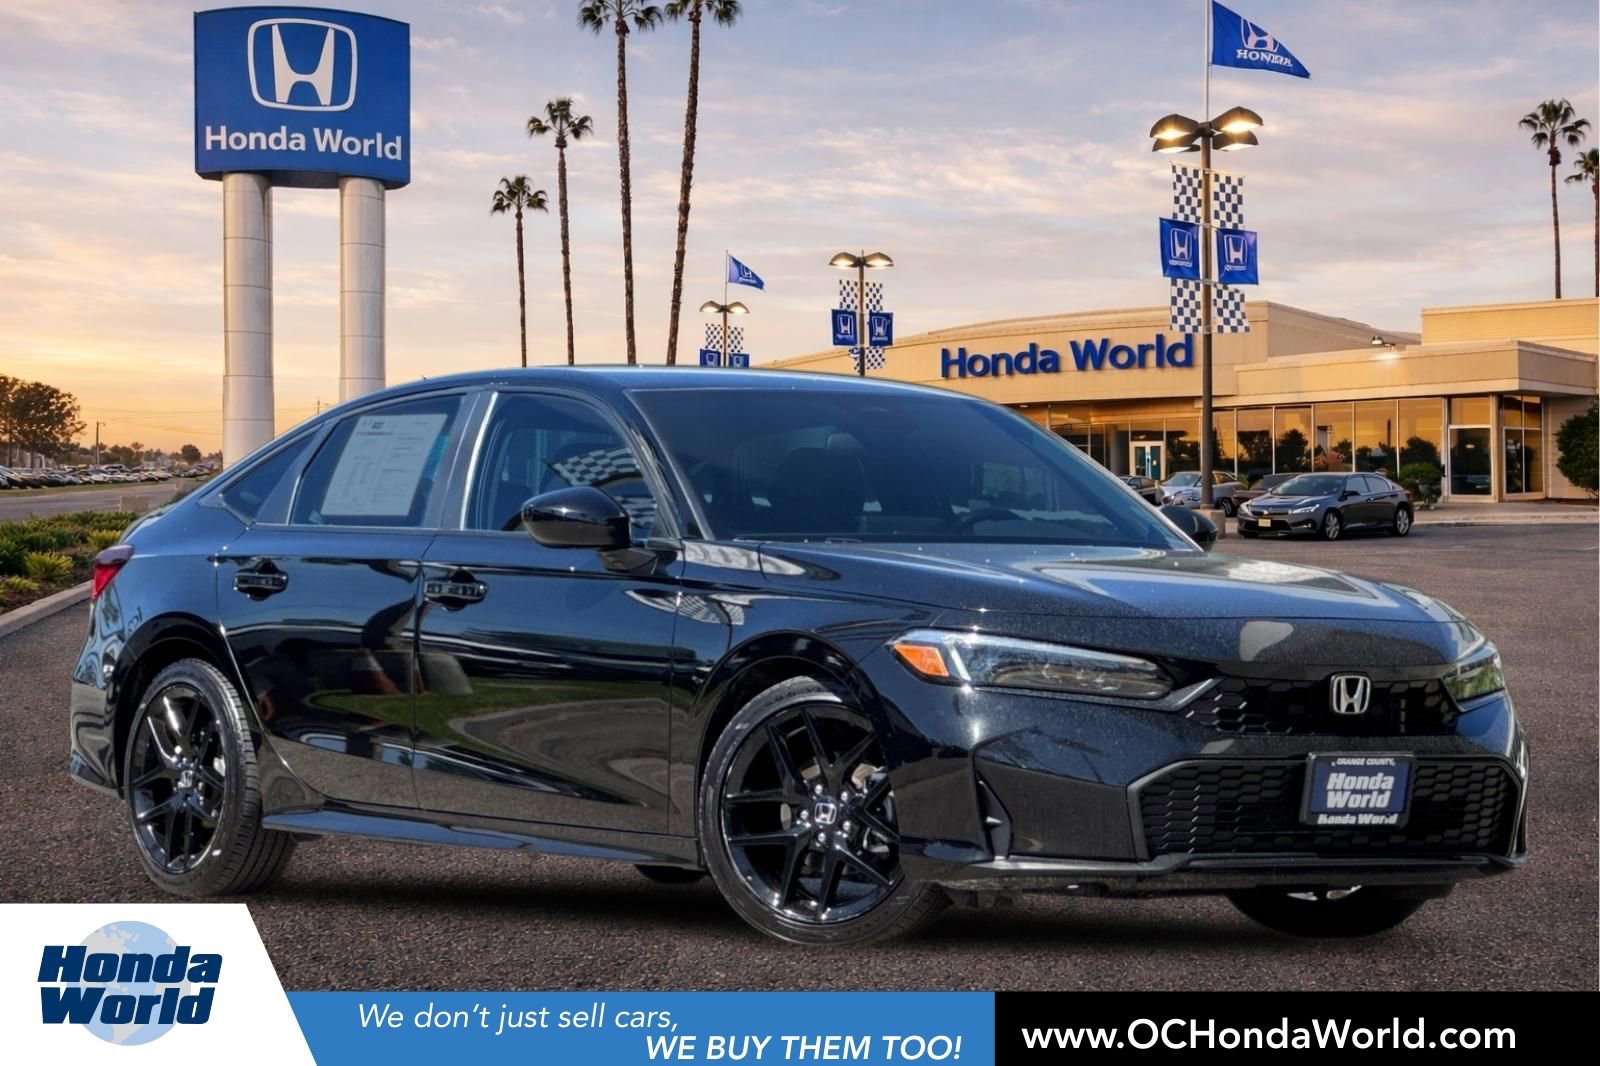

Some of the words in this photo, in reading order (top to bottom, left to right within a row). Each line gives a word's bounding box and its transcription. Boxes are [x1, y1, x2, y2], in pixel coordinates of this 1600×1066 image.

[205, 125, 306, 151] Honda
[313, 127, 402, 160] World
[941, 342, 1061, 378] Honda
[1069, 333, 1195, 370] World
[1326, 772, 1395, 790] Honda
[1327, 790, 1392, 809] World
[1317, 813, 1357, 825] Honda
